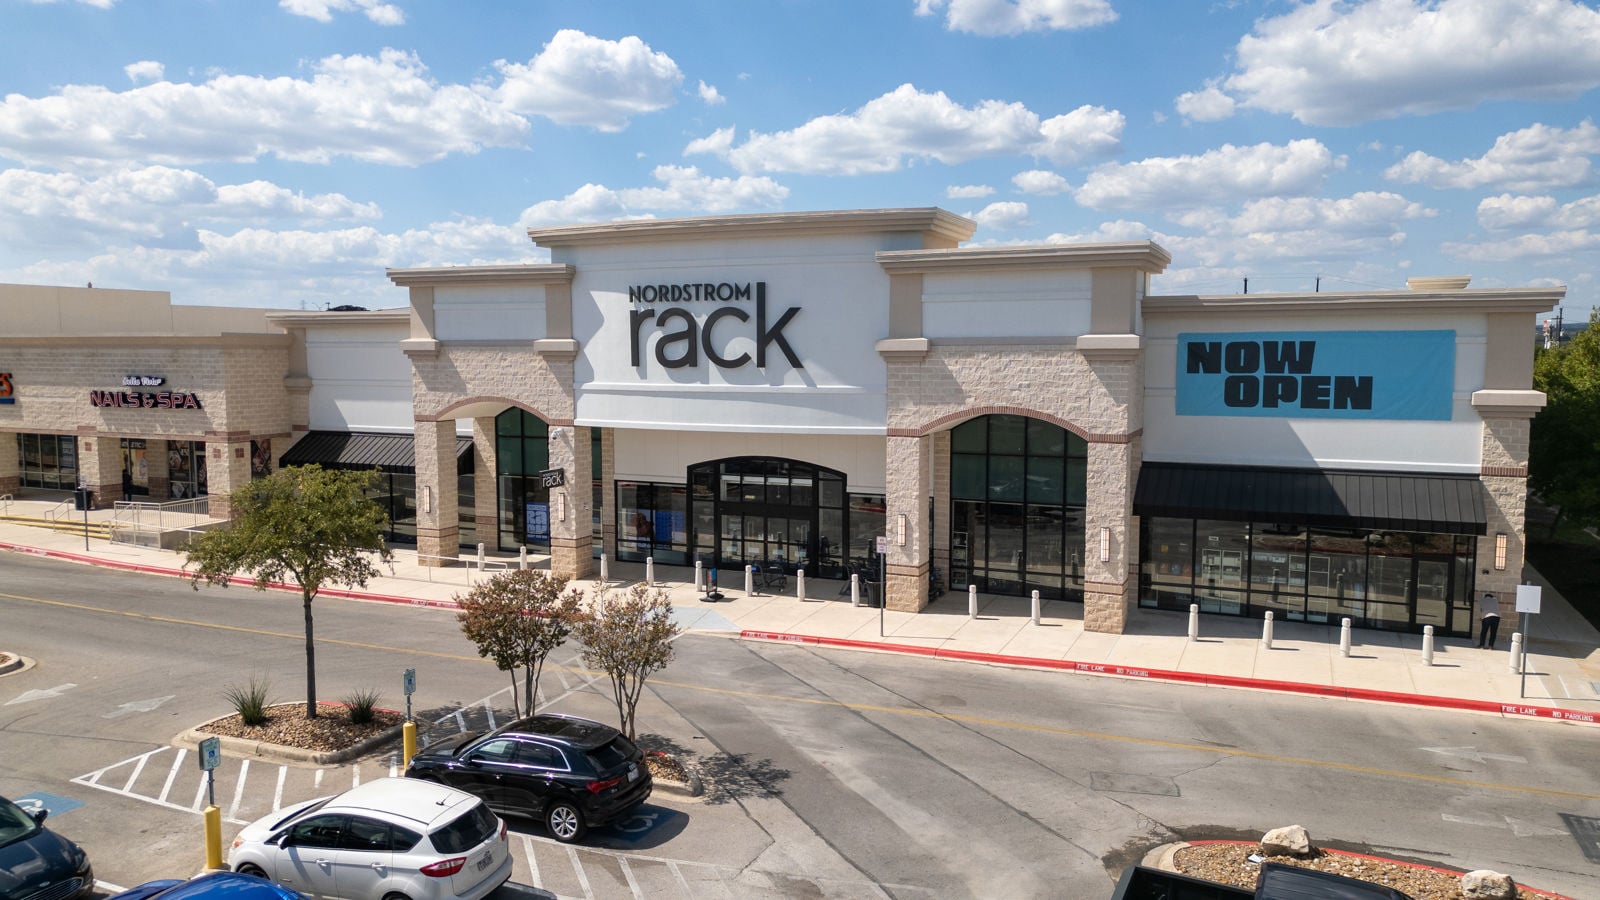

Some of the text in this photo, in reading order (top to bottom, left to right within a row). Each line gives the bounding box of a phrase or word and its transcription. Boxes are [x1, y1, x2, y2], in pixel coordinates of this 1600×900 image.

[629, 283, 750, 303] NORDSTROM
[629, 282, 804, 368] rack
[1187, 341, 1316, 374] NOW
[90, 391, 198, 409] NAILS & SPA
[1224, 375, 1373, 410] OPEN
[542, 471, 562, 488] rack
[1502, 705, 1594, 722] FIRE LANE NO PARKING
